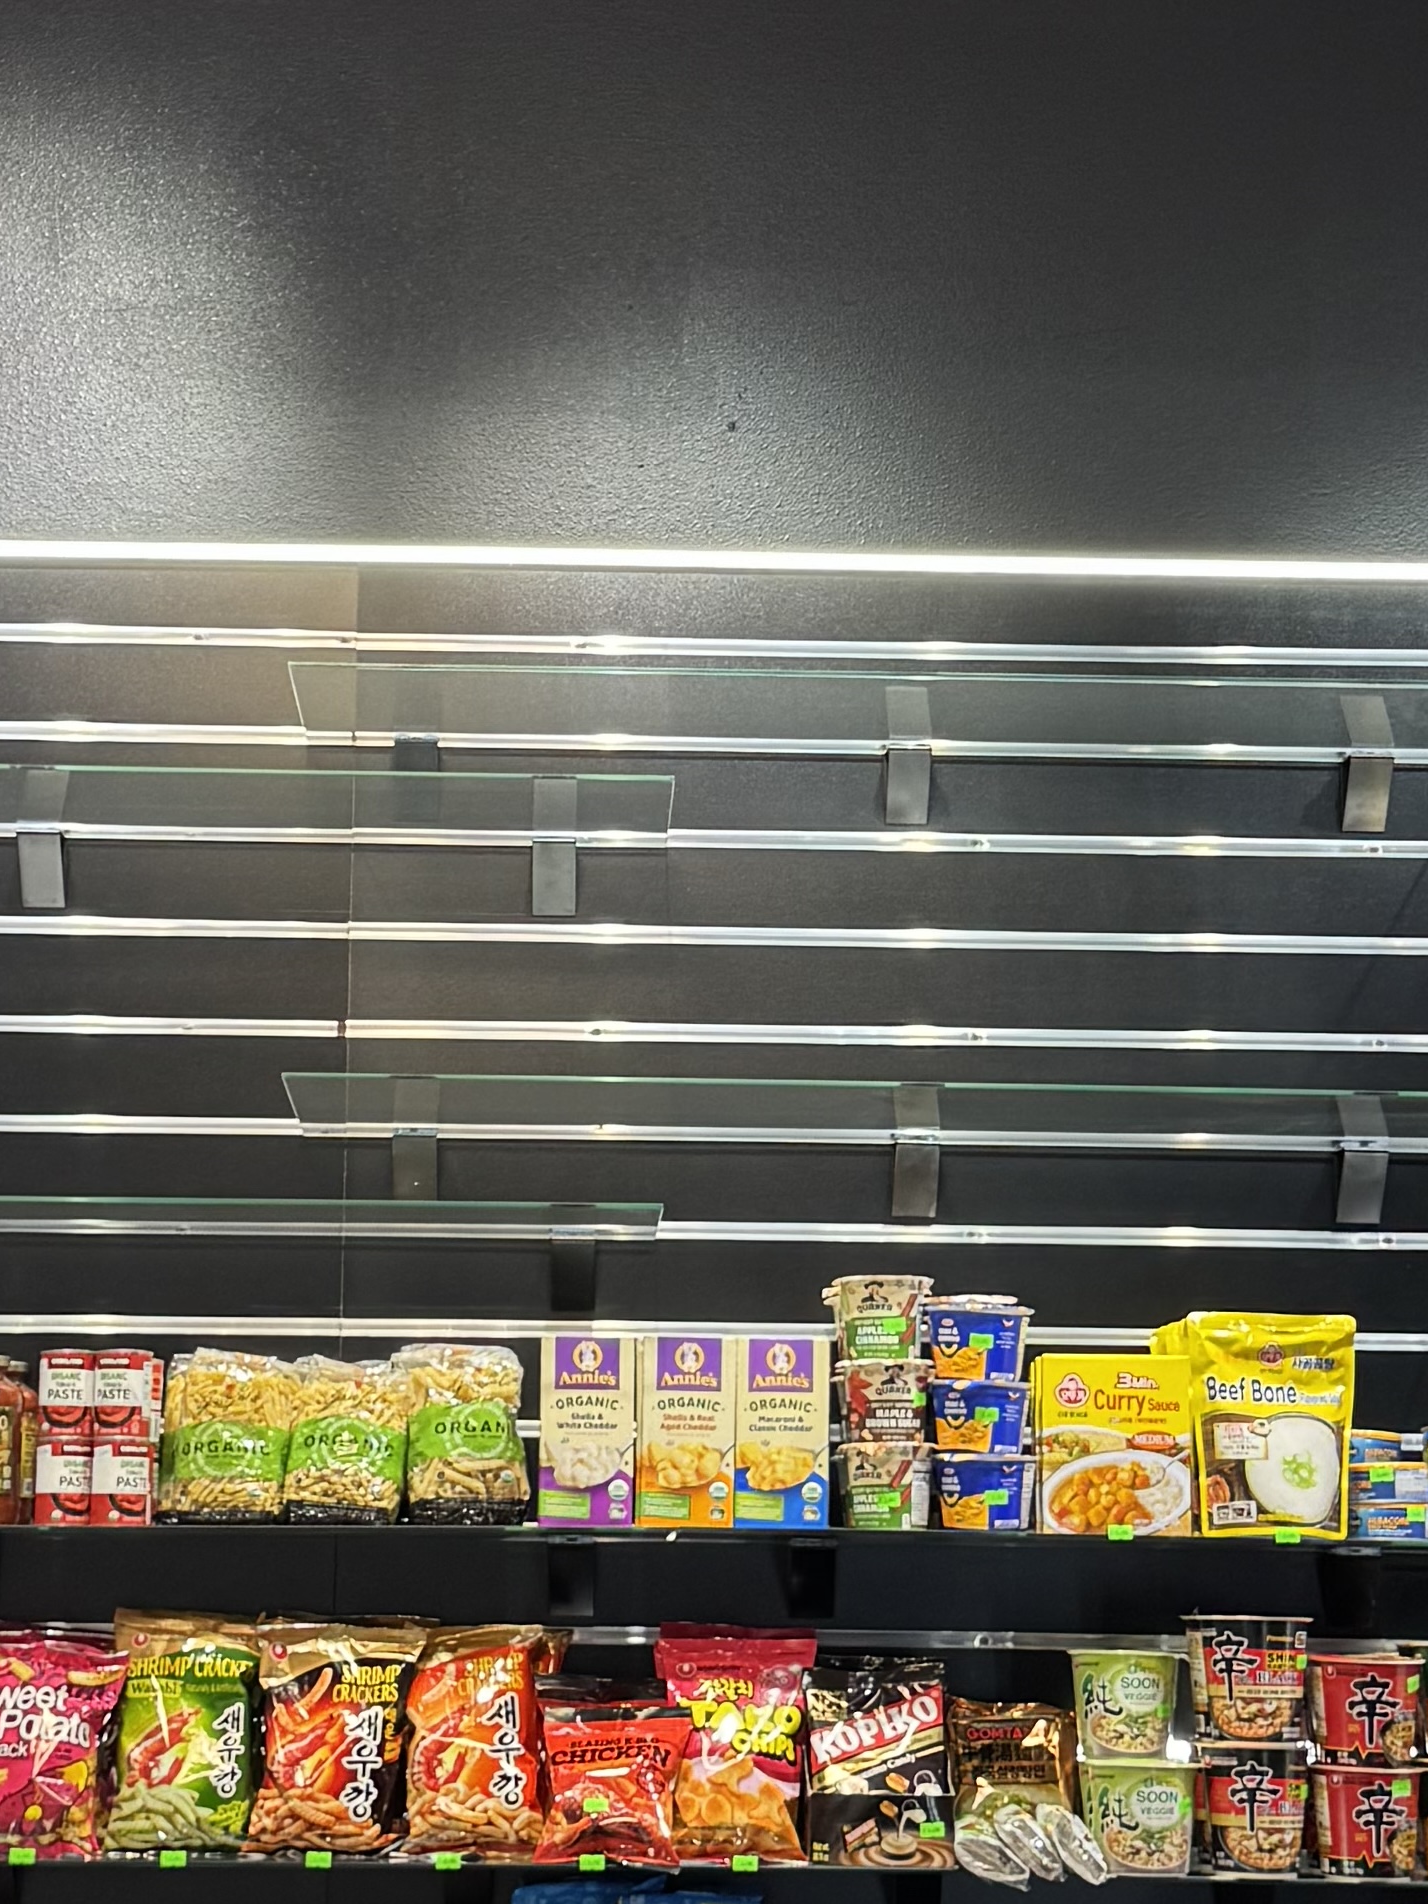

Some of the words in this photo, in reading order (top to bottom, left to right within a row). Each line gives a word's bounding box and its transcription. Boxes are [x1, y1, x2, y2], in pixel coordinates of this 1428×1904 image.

[559, 1369, 617, 1387] Annie's
[661, 1370, 718, 1388] Annie's
[753, 1371, 810, 1388] Annie's
[48, 1389, 83, 1400] PASTE
[97, 1389, 131, 1400] PASTE
[1206, 1377, 1246, 1400] Beef
[1252, 1380, 1297, 1404] Bone
[555, 1397, 619, 1410] ORGANIC
[658, 1398, 720, 1412] ORGANIC
[750, 1399, 812, 1413] ORGANIC
[1094, 1390, 1144, 1415] Curry
[1148, 1398, 1180, 1412] Sauce
[181, 1440, 272, 1457] ORGANIC
[340, 1664, 401, 1684] SHRIMP
[1121, 1677, 1160, 1689] SOON
[332, 1684, 398, 1703] CRACKERS
[1124, 1692, 1158, 1701] VEGGIE
[812, 1692, 941, 1764] KOPIKO
[212, 1702, 244, 1798] 새우깡
[482, 1693, 526, 1808] 새우깡
[551, 1746, 671, 1766] CHICKEN
[340, 1706, 383, 1822] 새우깡
[1136, 1790, 1178, 1803] SOON
[1140, 1806, 1175, 1815] VEGGIE
